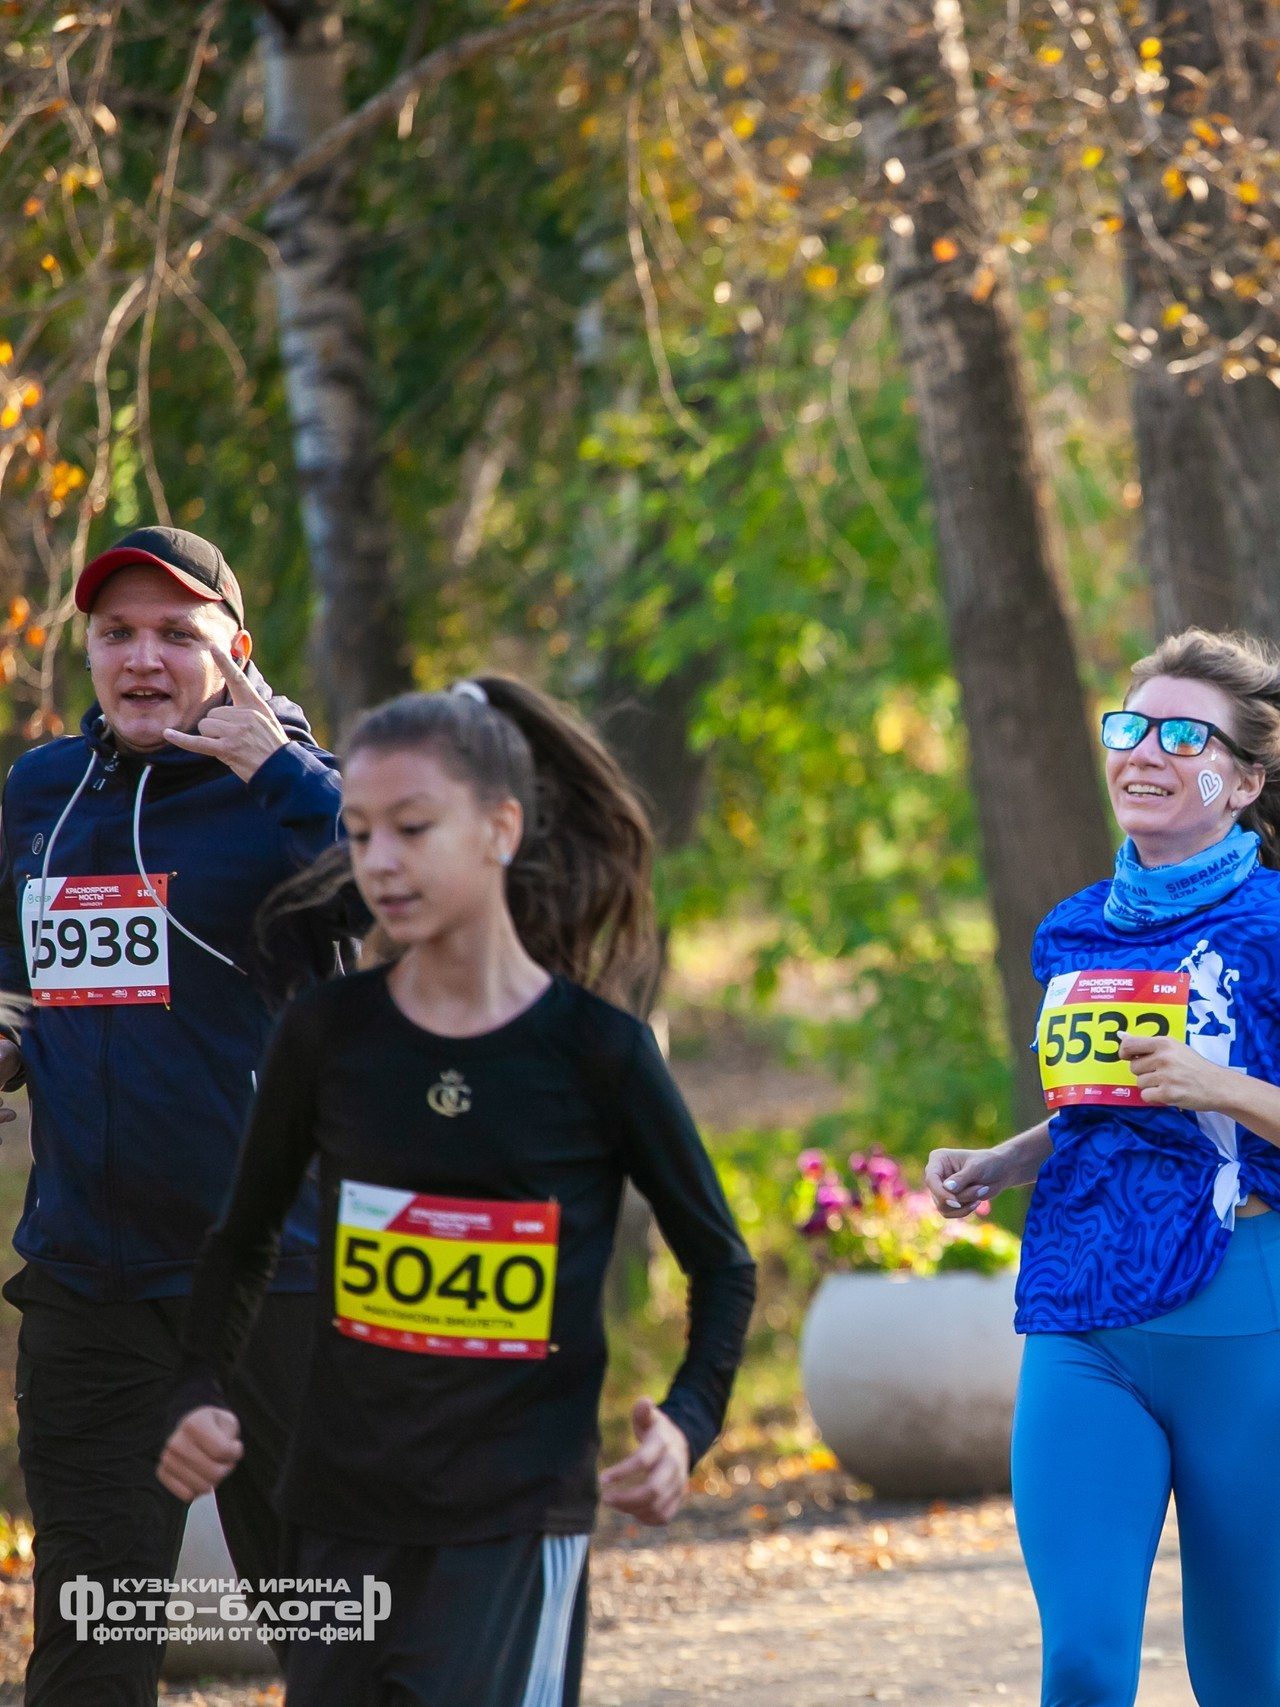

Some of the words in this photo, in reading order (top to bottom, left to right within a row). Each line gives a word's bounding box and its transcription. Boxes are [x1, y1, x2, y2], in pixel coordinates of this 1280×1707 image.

[1165, 850, 1240, 893] SIBERMAN
[65, 885, 119, 894] КРАСНОЯРСКИЕ
[1169, 886, 1198, 901] ULTRA
[78, 893, 104, 901] МОСТЫ
[31, 916, 160, 969] 5938
[1078, 979, 1133, 987] КРАСНОЯРСКИЕ
[137, 989, 156, 997] 2026
[1090, 986, 1116, 994] МОСТЫ
[1153, 984, 1159, 993] 5
[341, 1236, 546, 1313] 5040
